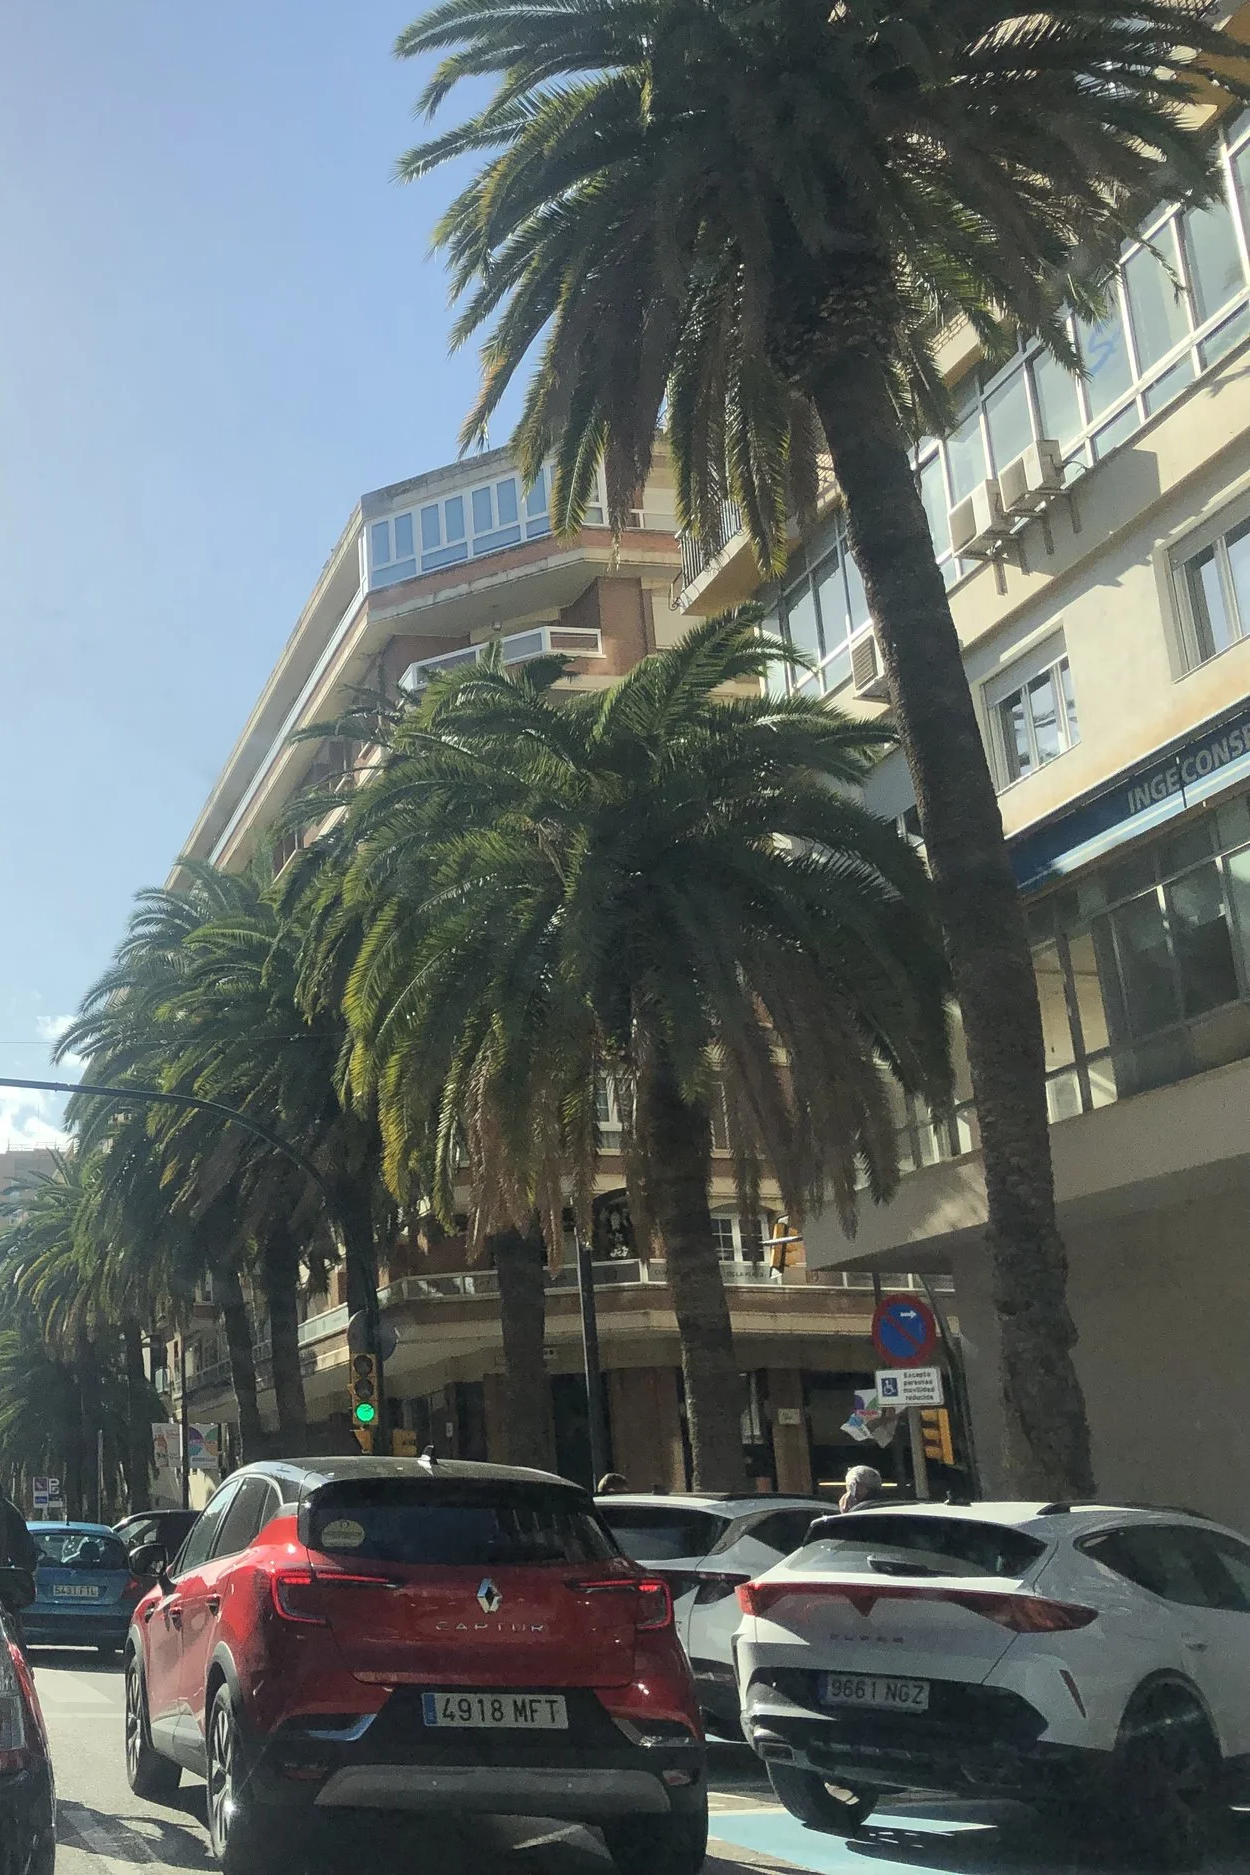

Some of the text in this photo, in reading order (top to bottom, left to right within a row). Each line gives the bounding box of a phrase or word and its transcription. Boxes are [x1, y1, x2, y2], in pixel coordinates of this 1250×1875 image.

[830, 1681, 925, 1704] 9661 NGZ
[442, 1698, 558, 1723] 4918 MFT
